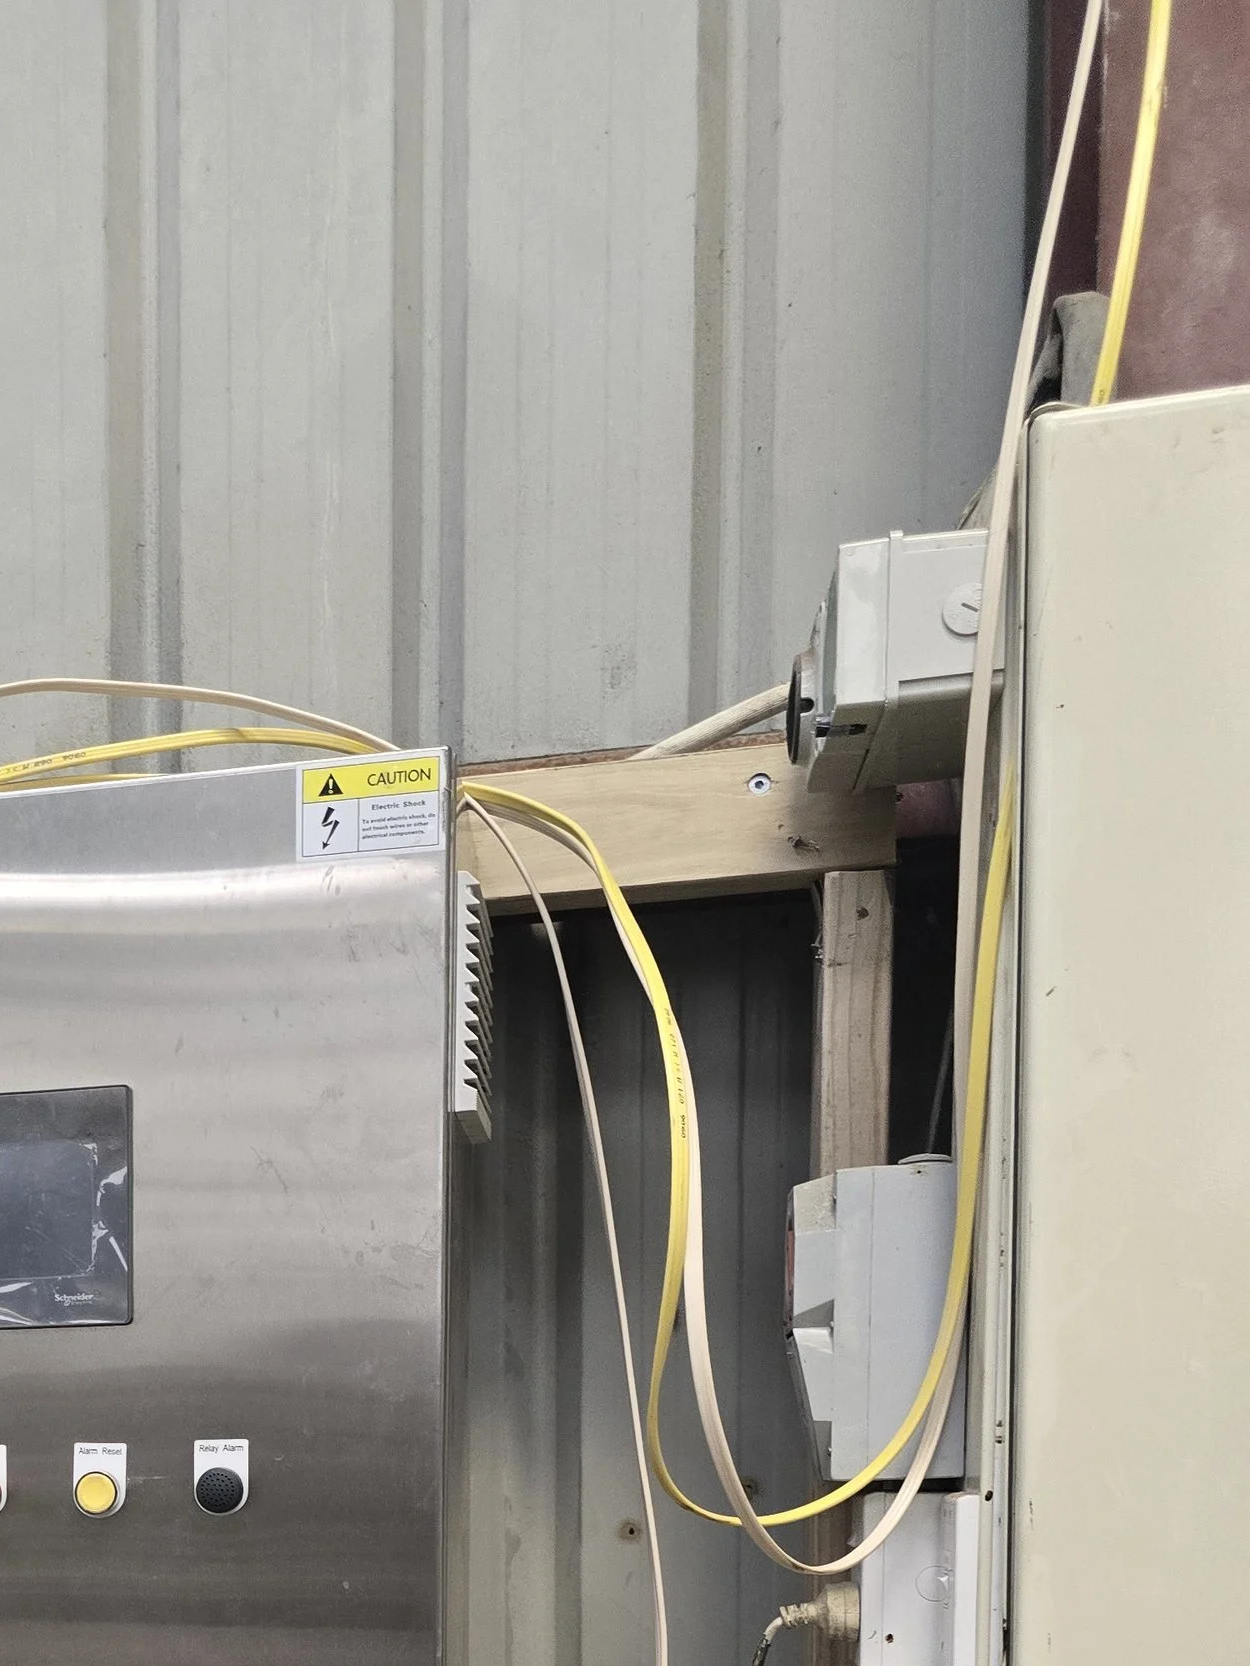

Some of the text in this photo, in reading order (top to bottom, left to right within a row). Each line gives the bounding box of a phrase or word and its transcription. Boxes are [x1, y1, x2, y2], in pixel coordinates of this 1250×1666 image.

[367, 768, 431, 786] CAUTION
[371, 799, 426, 811] Electric Shock
[362, 832, 388, 840] electrical
[54, 1293, 94, 1306] Schneider
[79, 1446, 123, 1455] Alarm Reset
[199, 1444, 244, 1454] Relay Alarm
